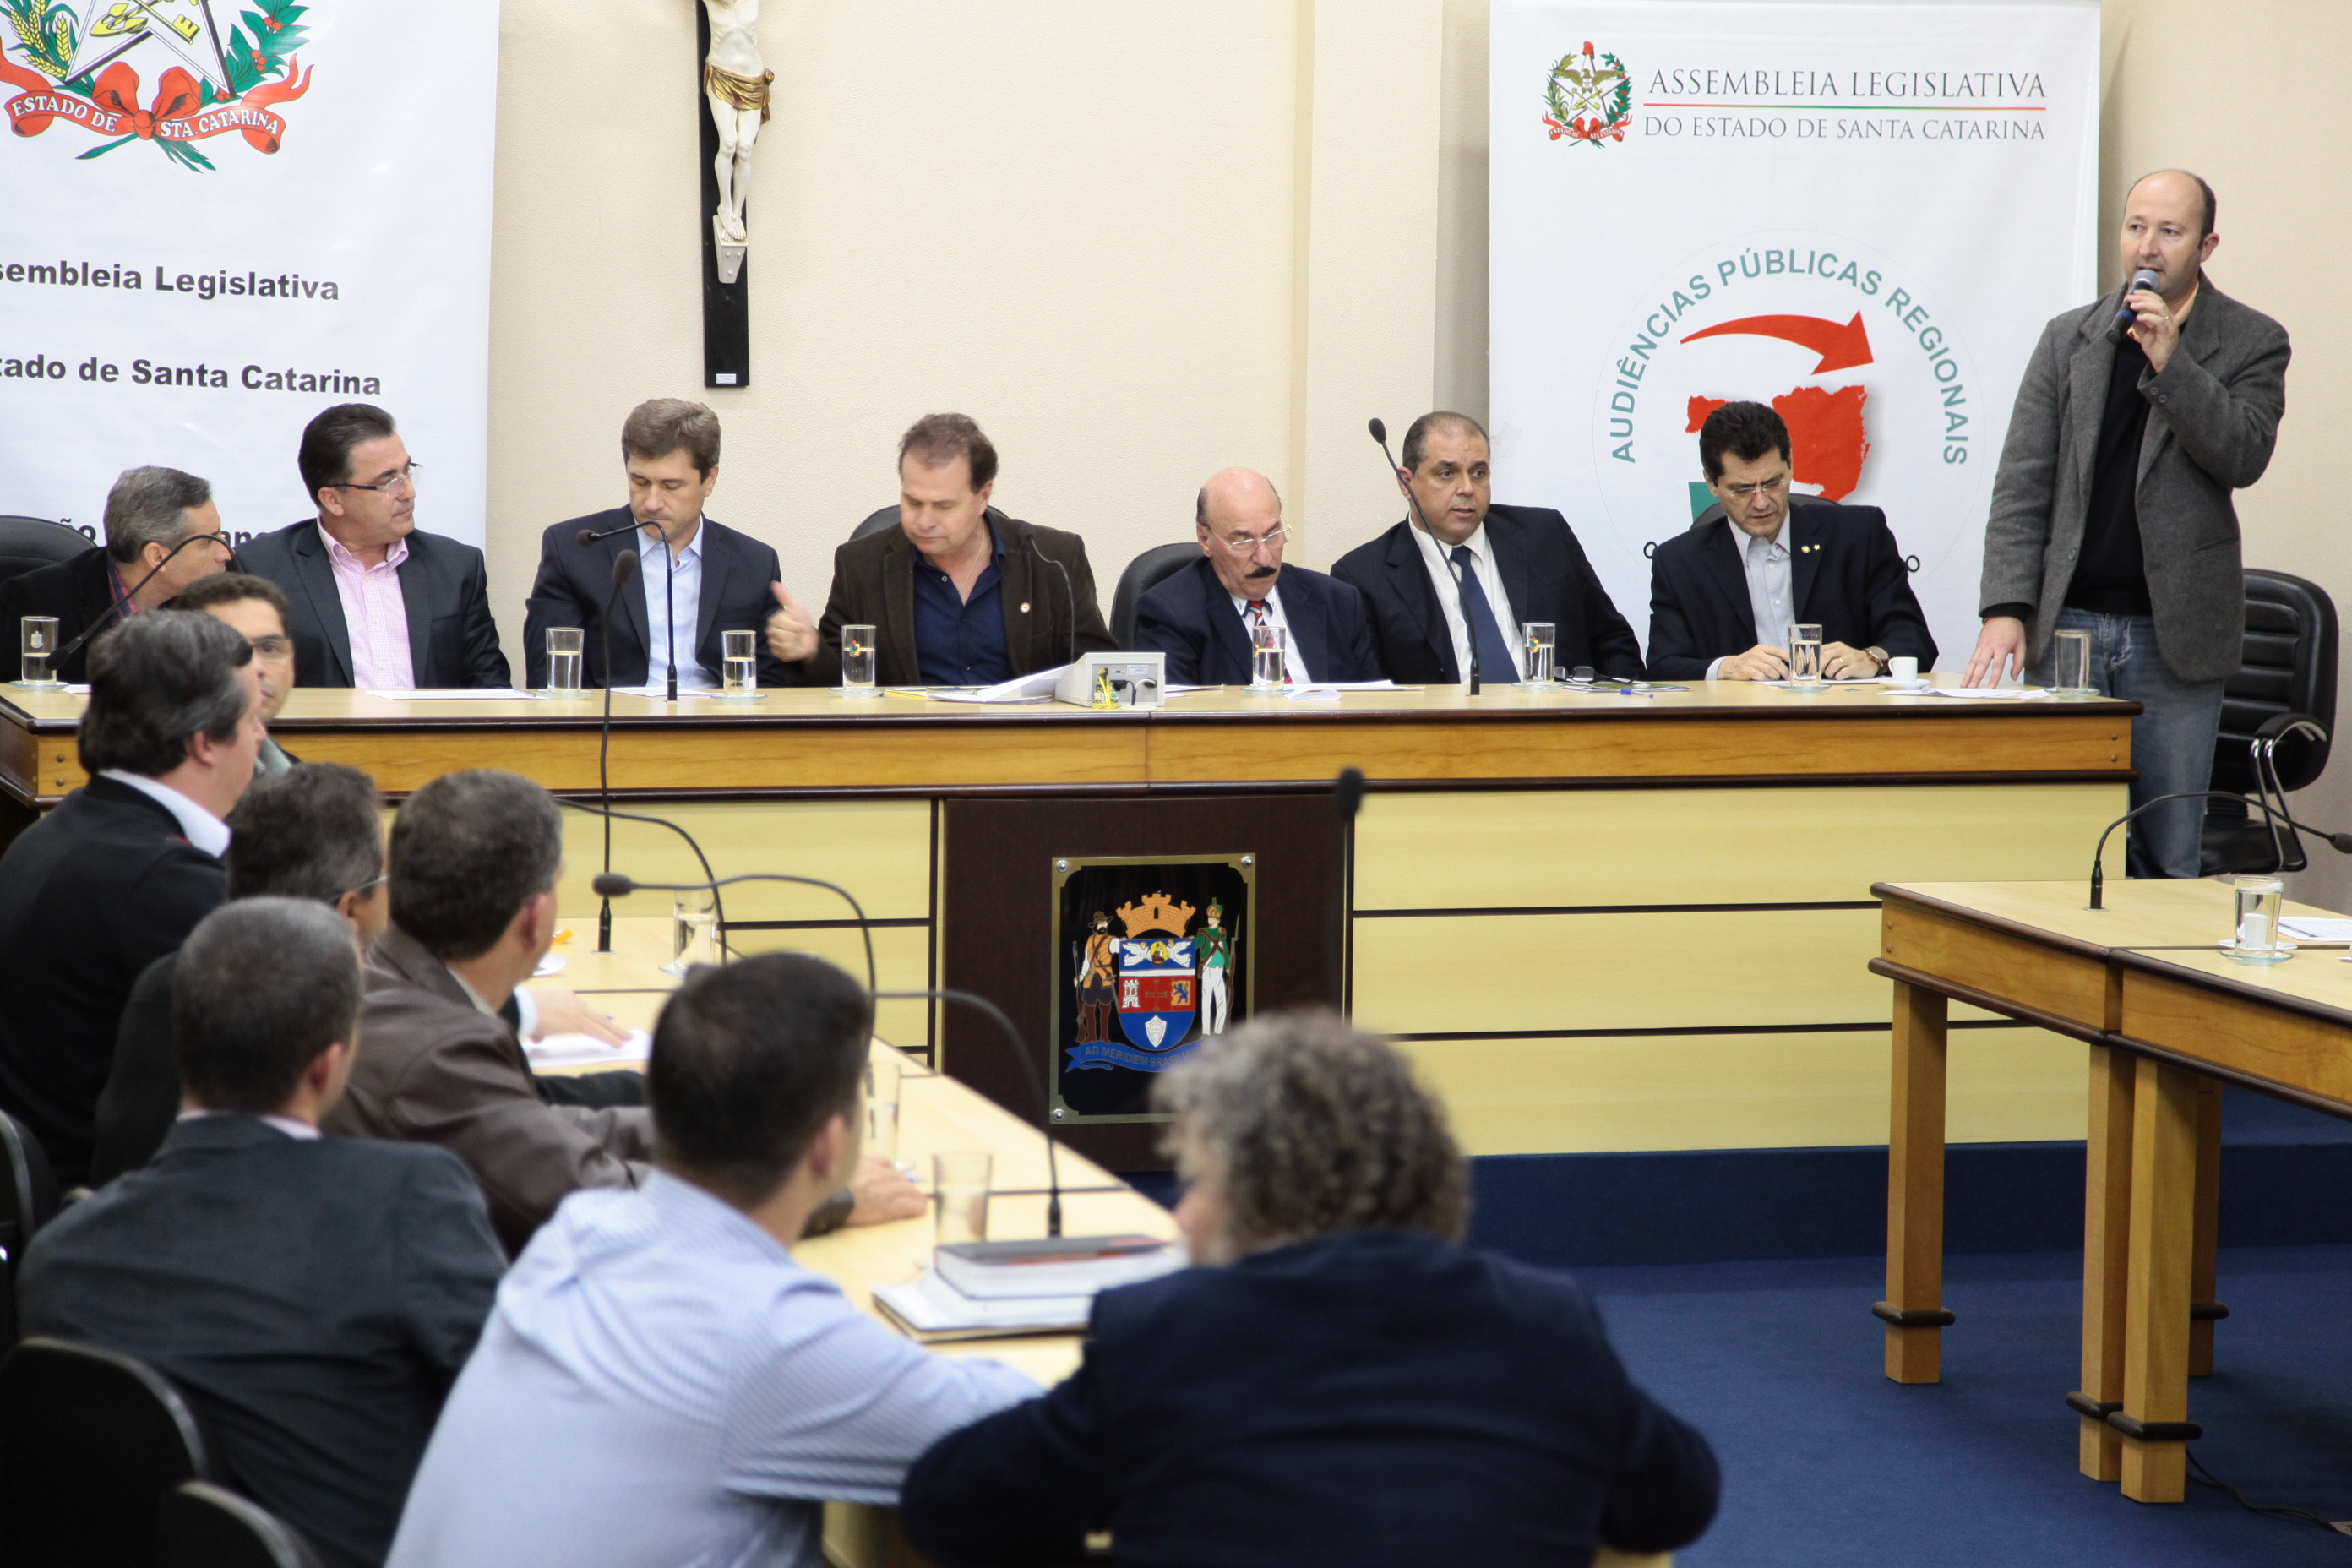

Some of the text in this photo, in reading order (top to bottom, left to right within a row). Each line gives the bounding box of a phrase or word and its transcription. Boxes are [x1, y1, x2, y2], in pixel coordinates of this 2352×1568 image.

[1647, 68, 2048, 98] ASSEMBLEIA LEGISLATIVA
[12, 95, 88, 120] ESTADO
[91, 112, 117, 133] DE
[1643, 116, 2046, 140] DO ESTADO DE SANTA CATARINA
[0, 259, 340, 300] embleia Legislativa
[0, 353, 381, 395] ado de Santa Catarina
[1609, 248, 1969, 466] AUDIÊNCIAS PÚBLICAS REGIONAIS
[1085, 1046, 1099, 1056] AD
[1102, 1047, 1149, 1067] MERIDIEM
